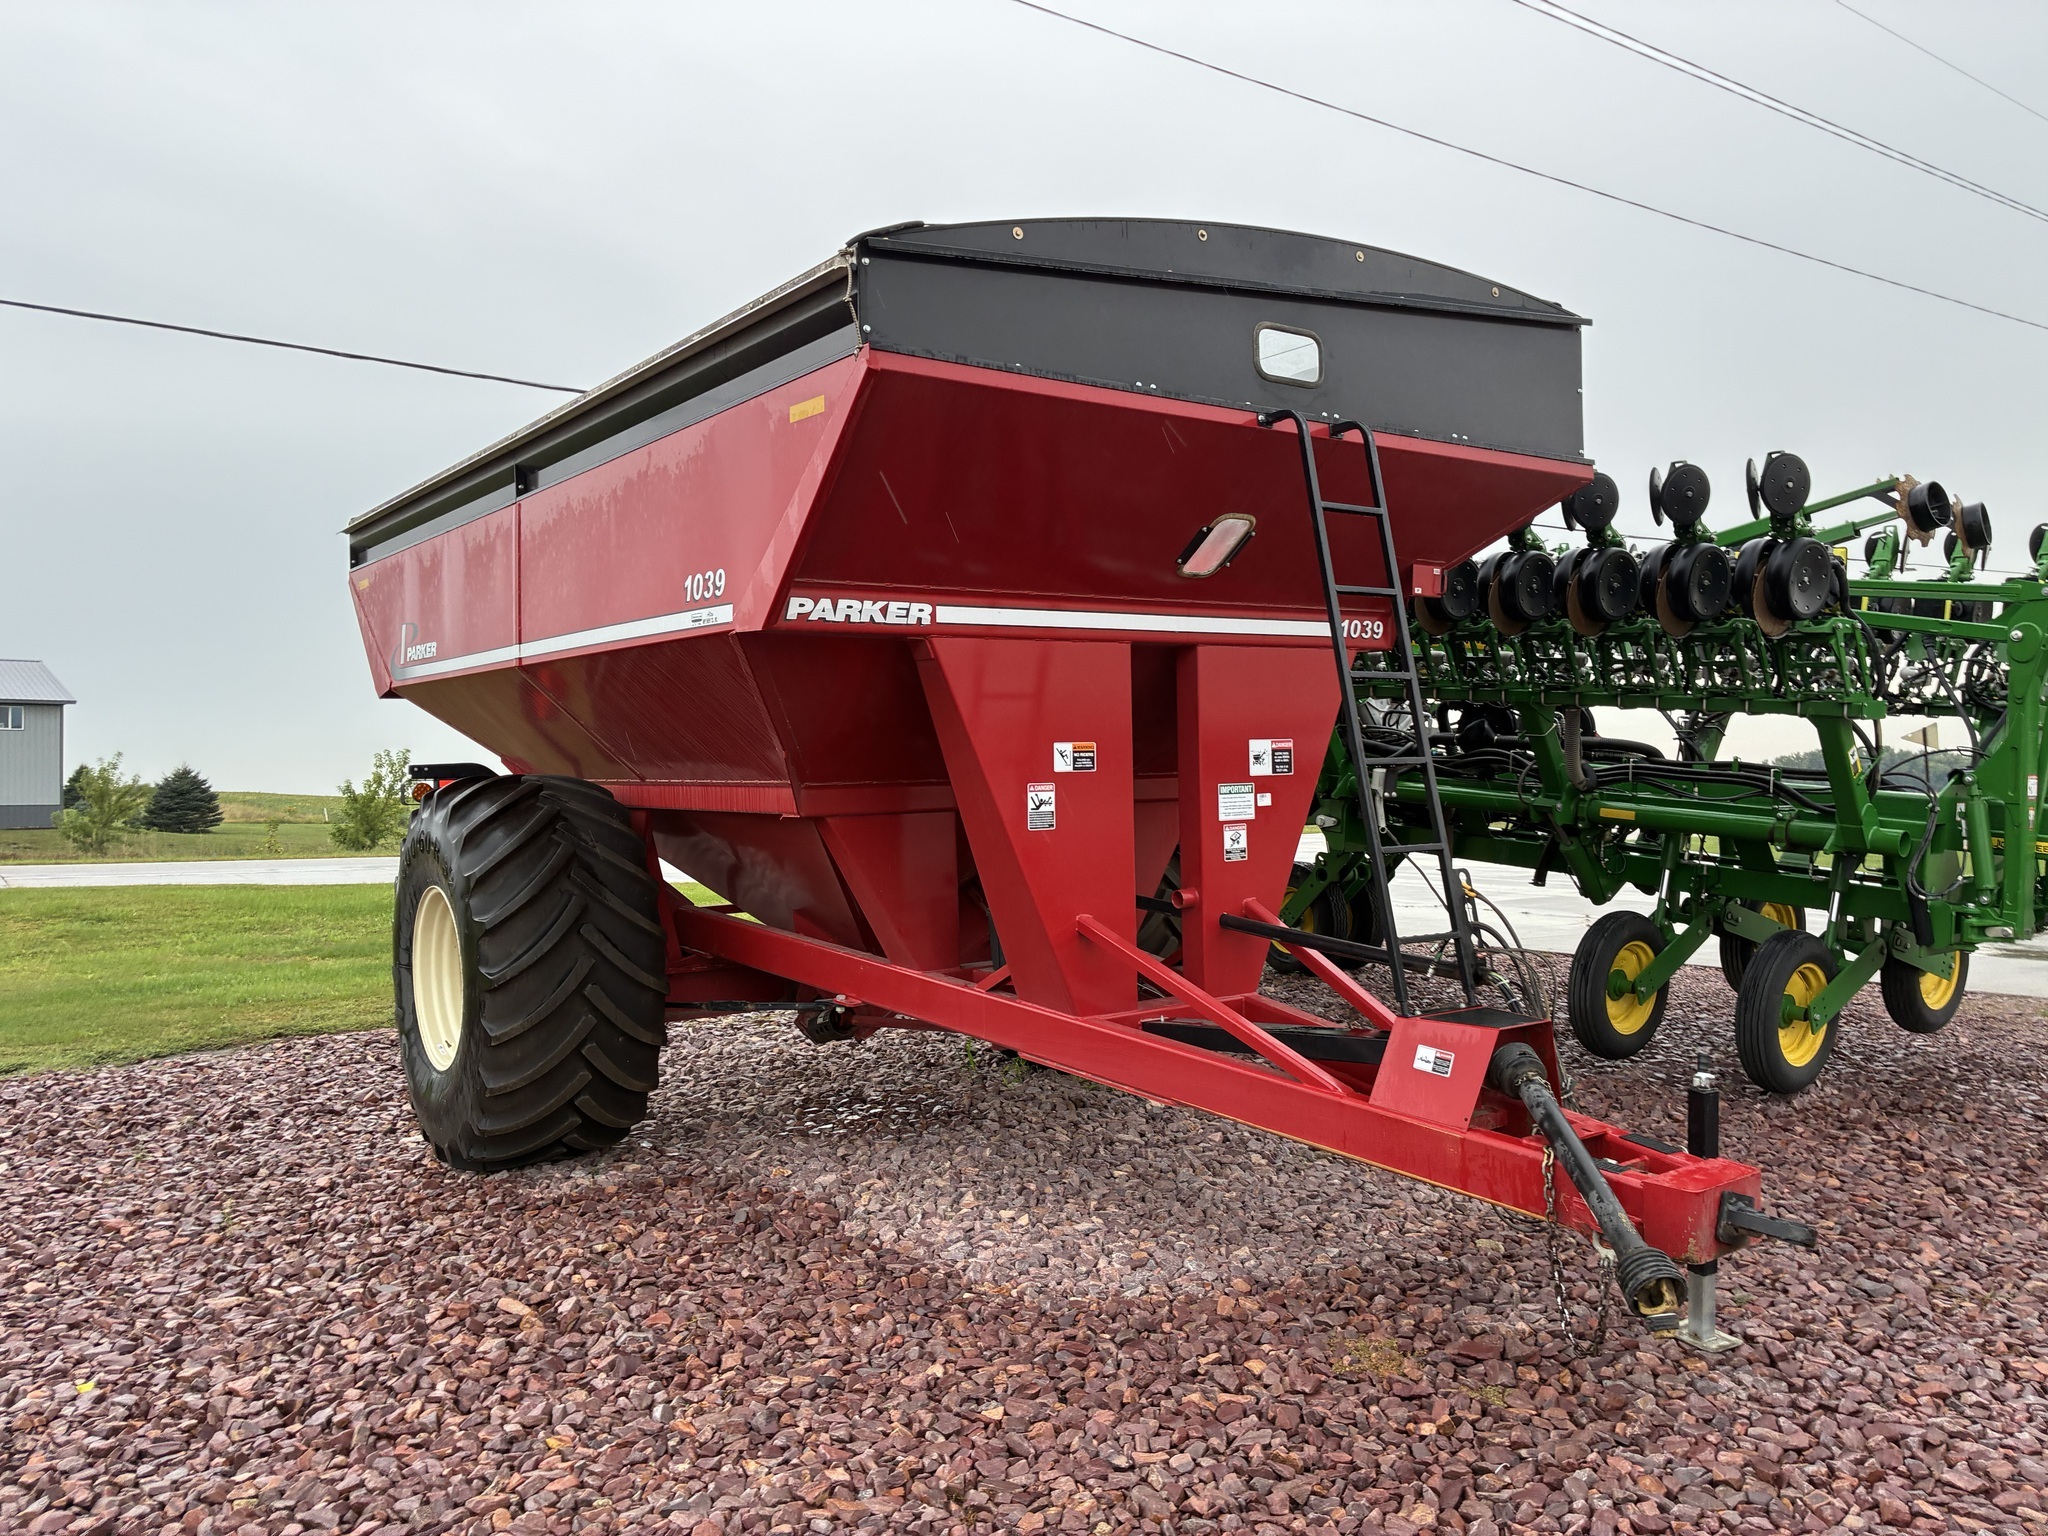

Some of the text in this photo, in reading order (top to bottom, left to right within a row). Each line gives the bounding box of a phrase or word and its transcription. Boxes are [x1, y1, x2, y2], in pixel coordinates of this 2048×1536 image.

[684, 568, 726, 602] 1039
[786, 596, 933, 626] PARKER
[1340, 619, 1384, 639] 1039
[406, 641, 437, 662] PARKER
[1220, 784, 1253, 794] IMPORTANT
